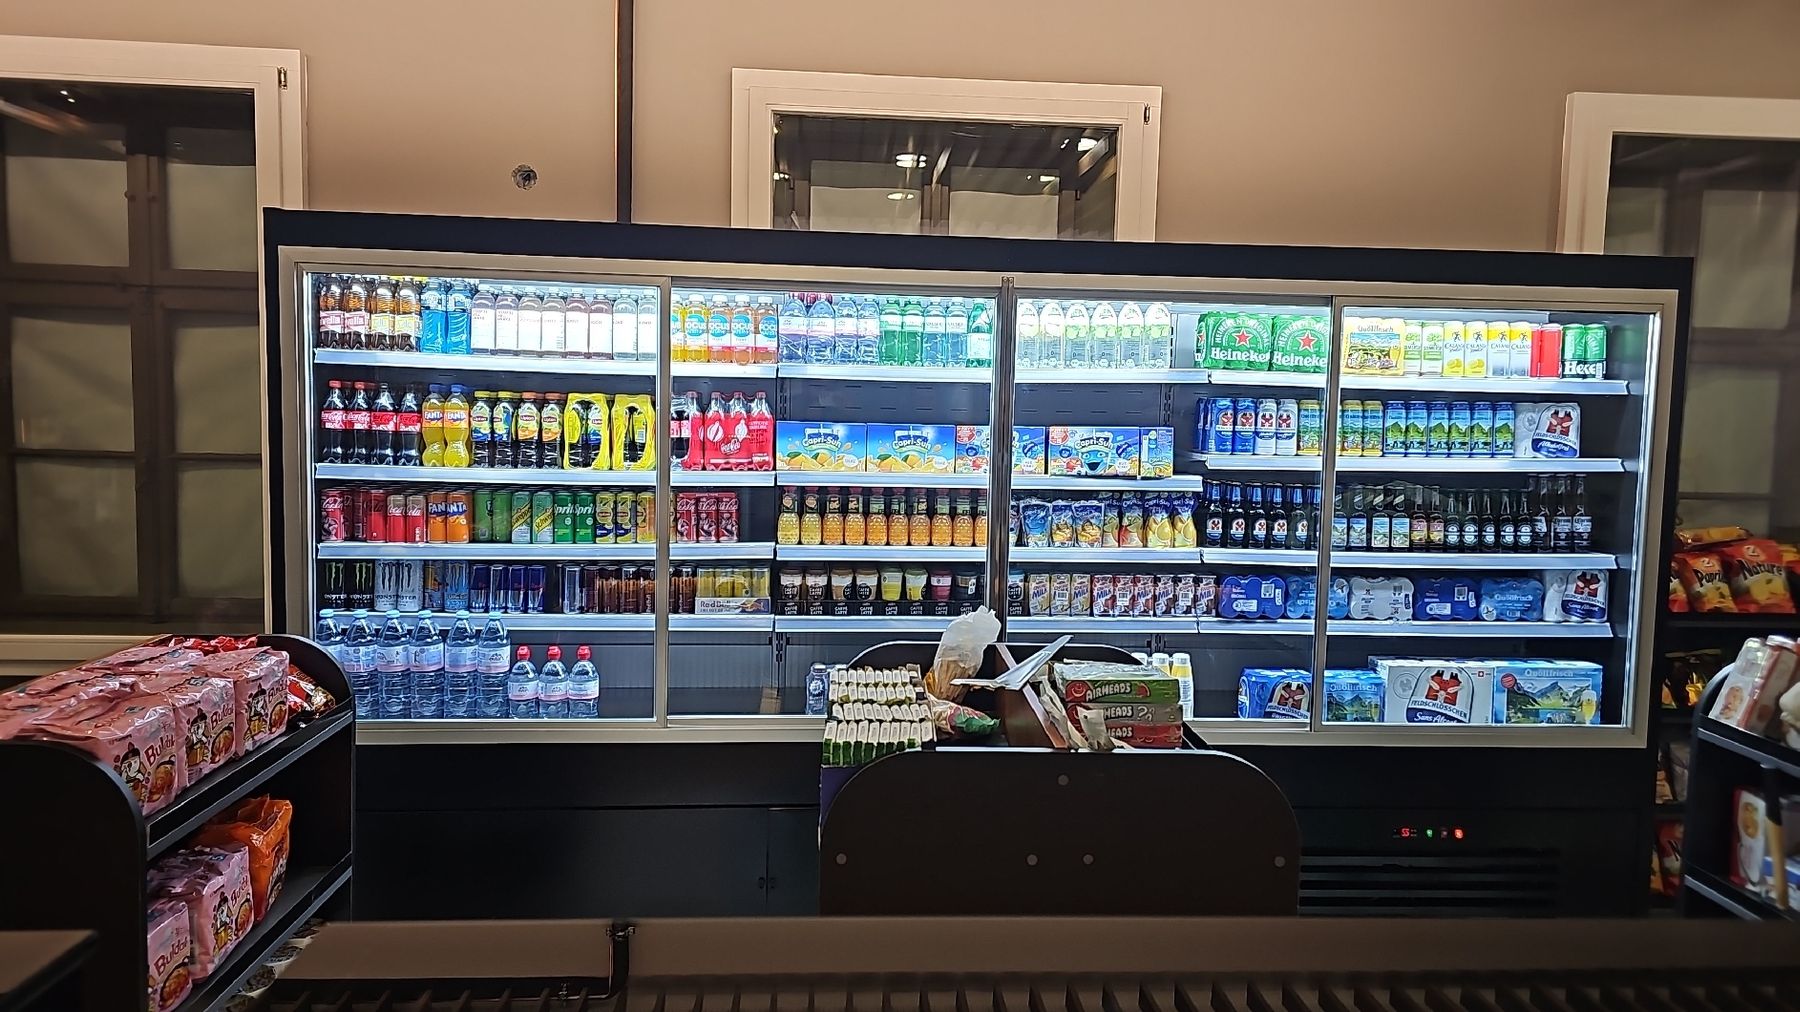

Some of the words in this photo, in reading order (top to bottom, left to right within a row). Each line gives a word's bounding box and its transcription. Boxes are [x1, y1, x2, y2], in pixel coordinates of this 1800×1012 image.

[802, 435, 842, 449] Capri-Sun
[892, 437, 931, 449] Capri-Sun
[1076, 438, 1113, 449] Capri-Sun
[554, 503, 574, 516] Sprit
[575, 503, 595, 516] Sprit
[1735, 558, 1783, 580] Nature
[1525, 668, 1574, 677] Quöllfrisch
[1086, 682, 1132, 702] AIRHEADS
[1103, 705, 1133, 718] HEADS
[1411, 700, 1468, 719] FELDSCHLÖSSCHEN
